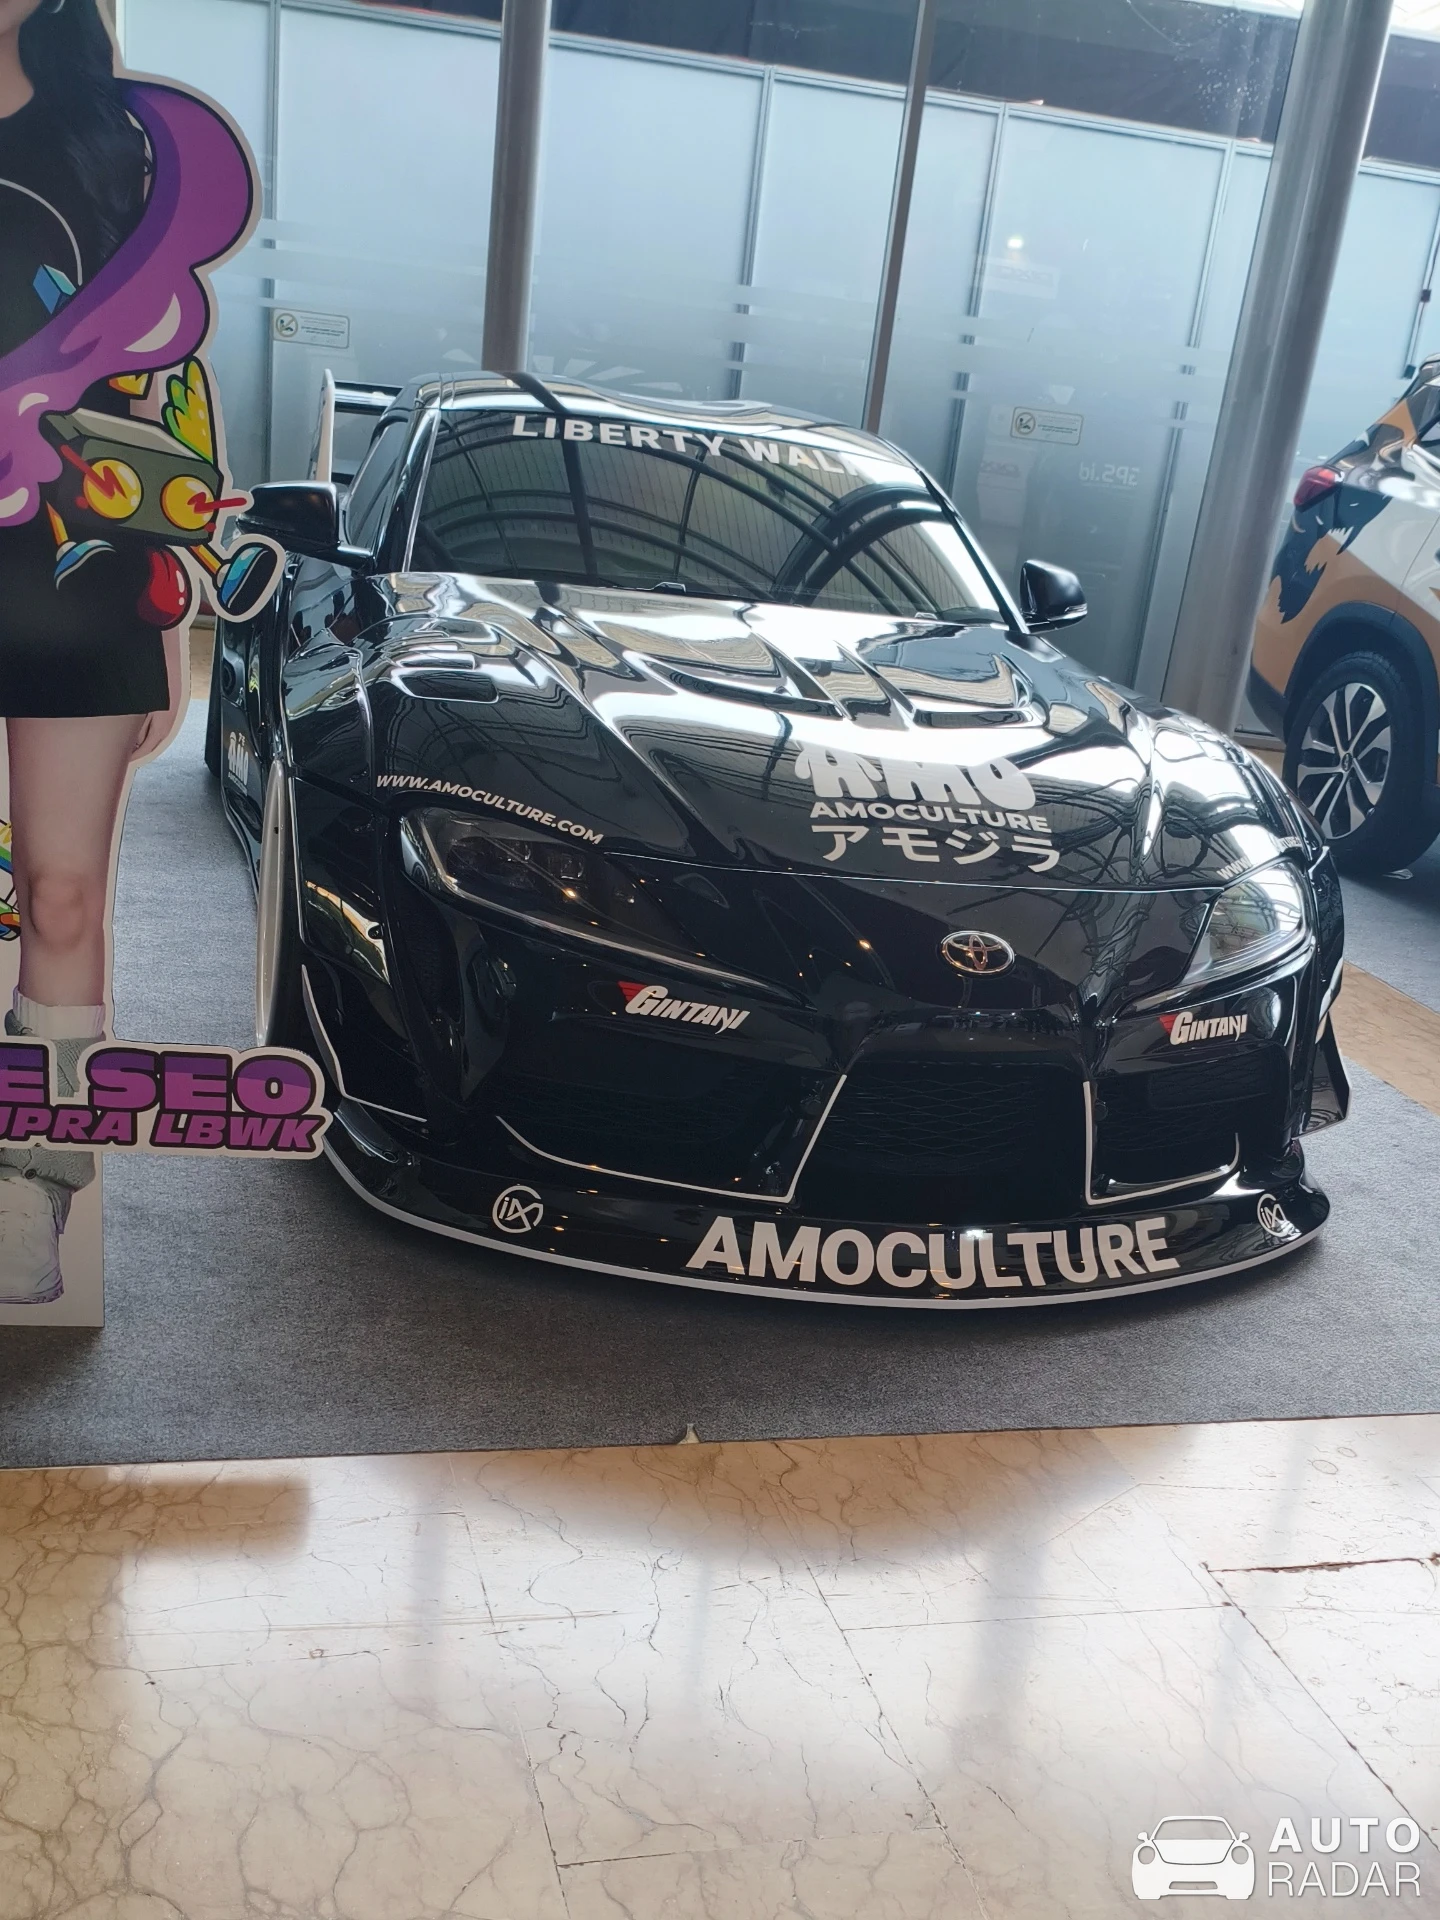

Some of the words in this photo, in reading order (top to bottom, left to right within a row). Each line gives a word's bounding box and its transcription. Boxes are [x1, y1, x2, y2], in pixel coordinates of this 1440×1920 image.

[512, 415, 725, 457] LIBERTY
[376, 775, 604, 845] WWW.AMOCULTURE.COM
[810, 802, 1052, 833] AMOCULTURE
[811, 825, 1060, 873] アモジラ
[88, 1049, 314, 1116] SEO
[153, 1112, 322, 1149] LBWK
[686, 1216, 1180, 1290] AMOCULTURE
